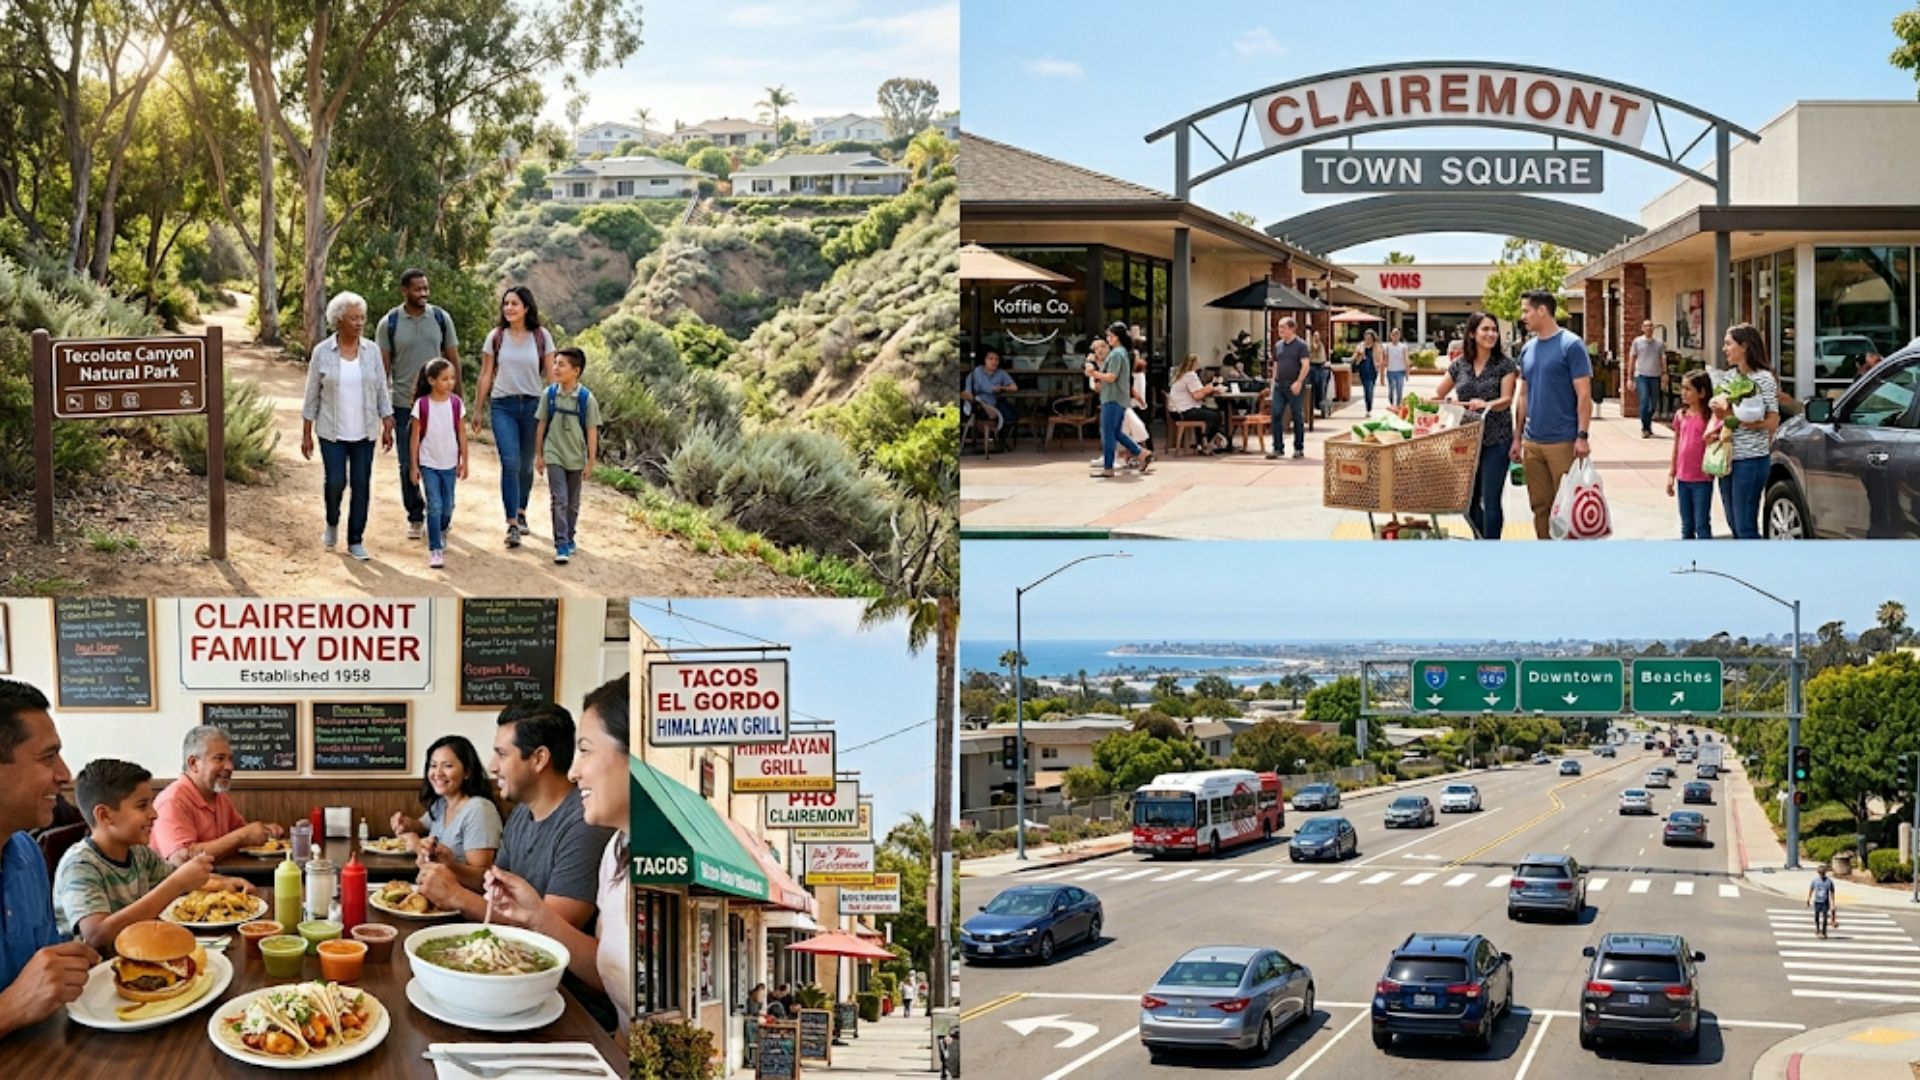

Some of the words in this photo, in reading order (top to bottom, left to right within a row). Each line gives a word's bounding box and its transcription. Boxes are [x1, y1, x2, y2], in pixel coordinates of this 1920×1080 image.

[1267, 74, 1641, 136] CLAIREMONT
[1315, 157, 1422, 185] TOWN
[1440, 157, 1591, 185] SQUARE
[1379, 273, 1421, 289] VONS
[993, 298, 1042, 314] Koffie
[1046, 298, 1074, 315] Co.
[63, 348, 132, 363] Tecolote
[135, 346, 194, 364] Canyon
[79, 364, 140, 381] Natural
[143, 364, 179, 379] Park
[195, 603, 416, 629] CLAIREMONT
[191, 636, 306, 661] FAMILY
[318, 636, 420, 661] DINER
[240, 669, 329, 682] Established
[335, 669, 371, 682] 1958
[678, 667, 758, 688] TACOS
[1528, 671, 1613, 683] Downtown
[1641, 671, 1712, 683] Beaches
[658, 693, 686, 712] EL
[694, 690, 779, 711] GORDO
[656, 718, 738, 737] HIMALAYAN
[742, 716, 782, 735] GRILL
[760, 759, 807, 775] GRILL
[633, 857, 688, 875] TACOS
